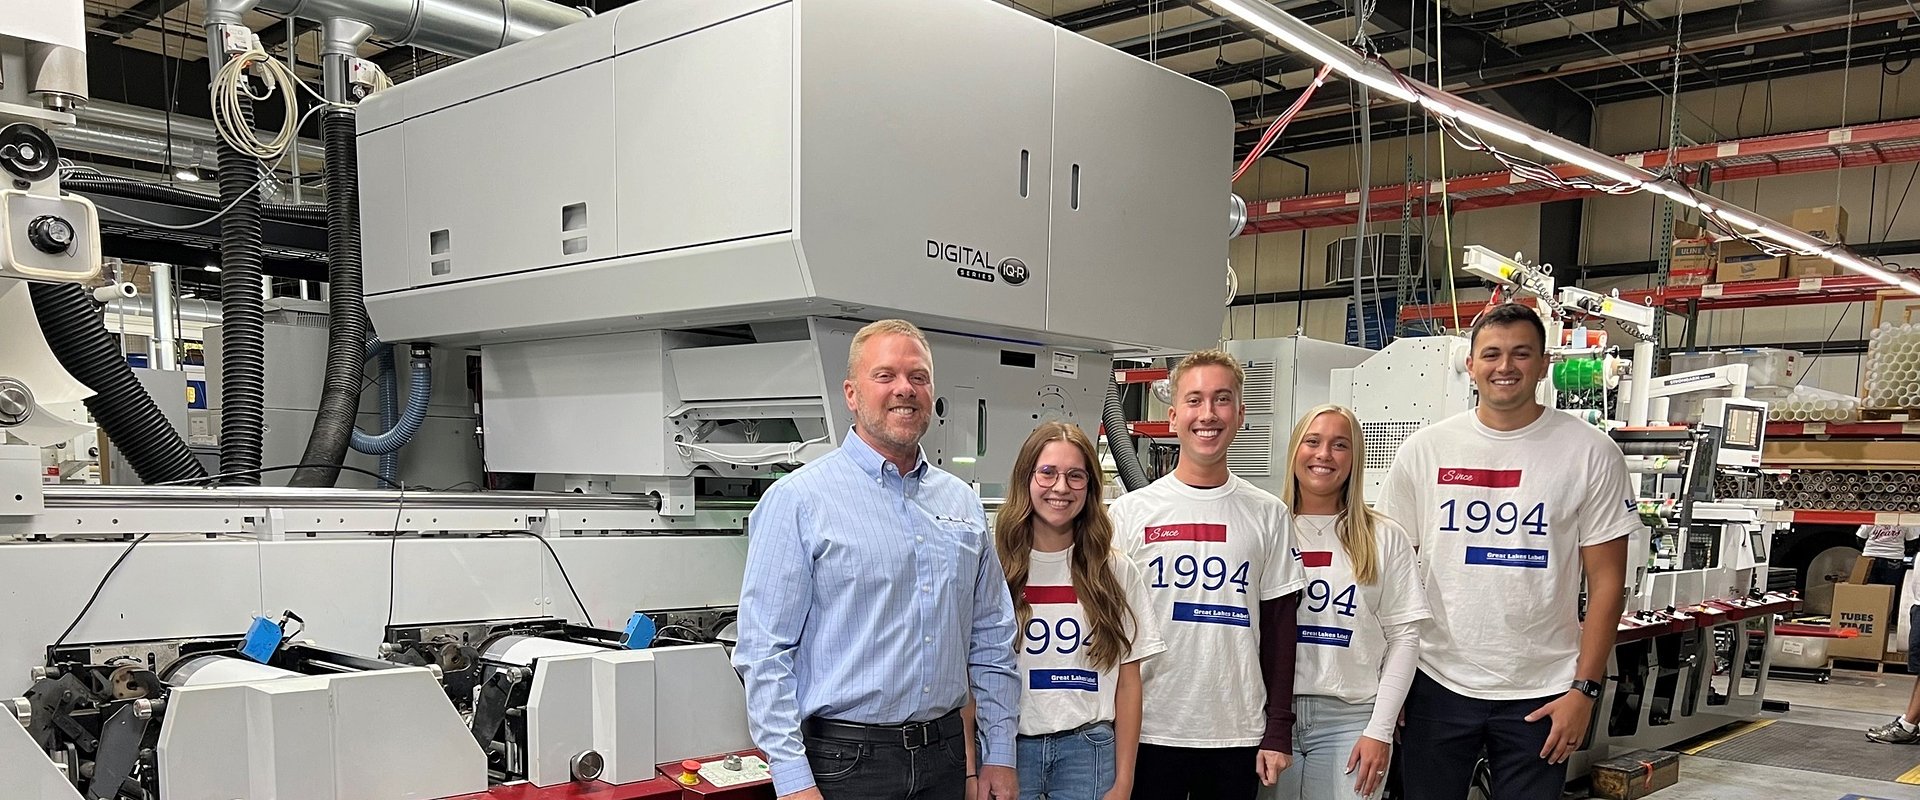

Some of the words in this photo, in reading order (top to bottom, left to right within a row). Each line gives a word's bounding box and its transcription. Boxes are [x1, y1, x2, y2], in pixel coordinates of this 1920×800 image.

[927, 240, 995, 270] DIGITAL
[960, 269, 992, 281] SERIES
[1442, 470, 1474, 482] Since
[1440, 499, 1548, 536] 1994
[1149, 528, 1180, 541] Since
[1148, 555, 1250, 594] 1994
[1193, 608, 1212, 616] Great
[1232, 611, 1249, 619] Label
[1840, 612, 1874, 622] TUBES
[1839, 621, 1874, 634] TIME
